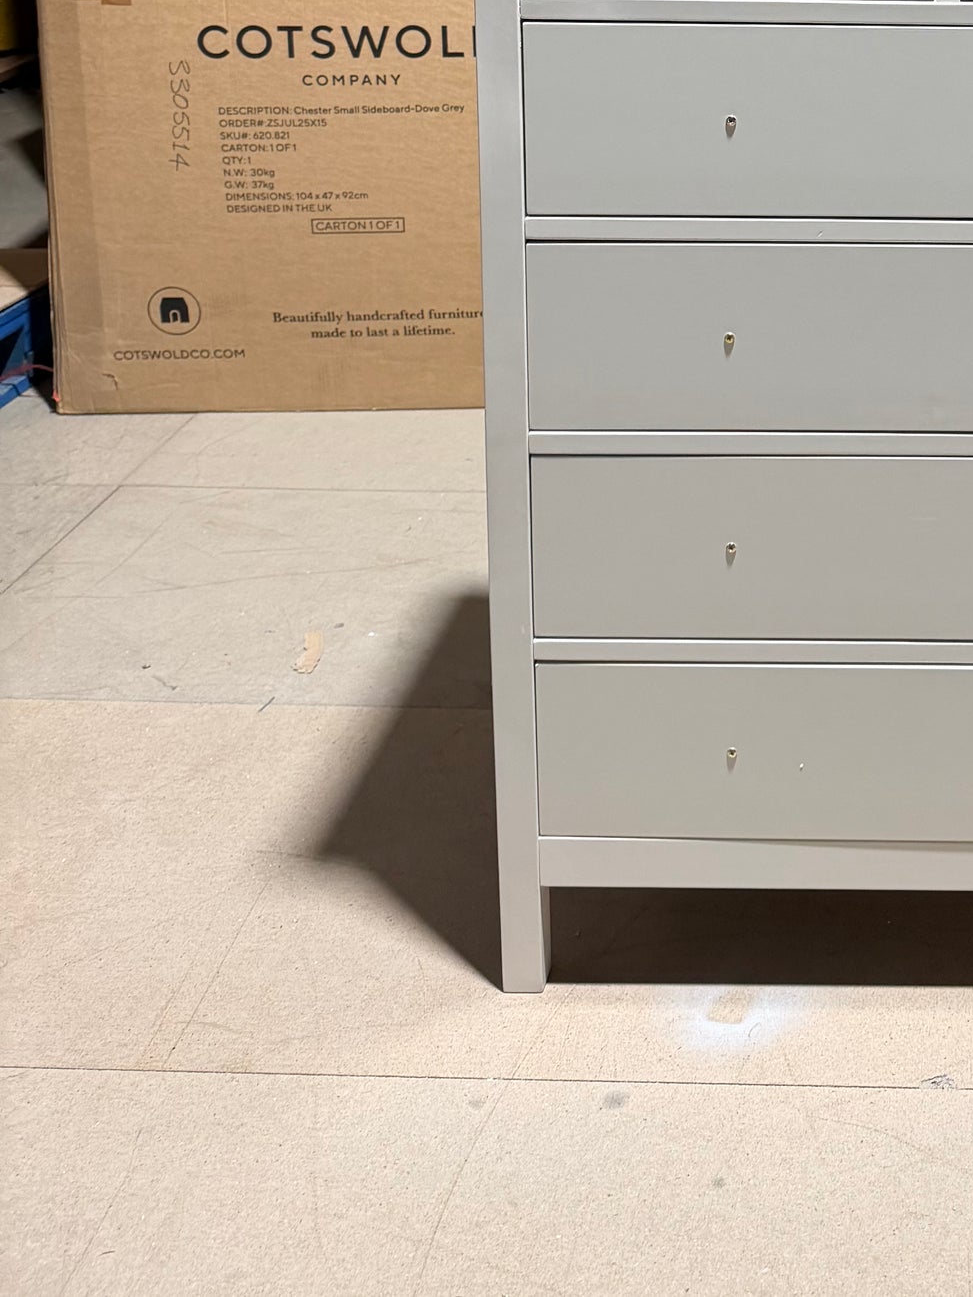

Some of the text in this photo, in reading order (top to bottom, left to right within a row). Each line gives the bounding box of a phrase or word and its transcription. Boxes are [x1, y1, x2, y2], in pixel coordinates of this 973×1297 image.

[302, 74, 400, 86] COMPANY
[218, 104, 464, 116] DESCRIPTION: Chester Small Sideboard-Dove Grey
[220, 131, 290, 140] SKU#: 620.821
[224, 168, 275, 178] N.W: 30kg
[224, 180, 274, 190] G.W: 37kg
[226, 192, 294, 201] DIMENSIONS:
[296, 192, 313, 200] 104
[342, 192, 368, 200] 92cm
[226, 204, 332, 214] DESIGNED IN THE UK
[315, 222, 366, 231] CARTON
[376, 220, 394, 230] OF
[272, 312, 343, 325] Beautifully
[347, 310, 424, 322] handcrafted
[311, 328, 346, 338] made
[350, 328, 363, 338] to
[366, 326, 388, 338] last
[404, 325, 456, 336] lifetime.
[114, 348, 246, 362] COTSWOLDCO.COM
